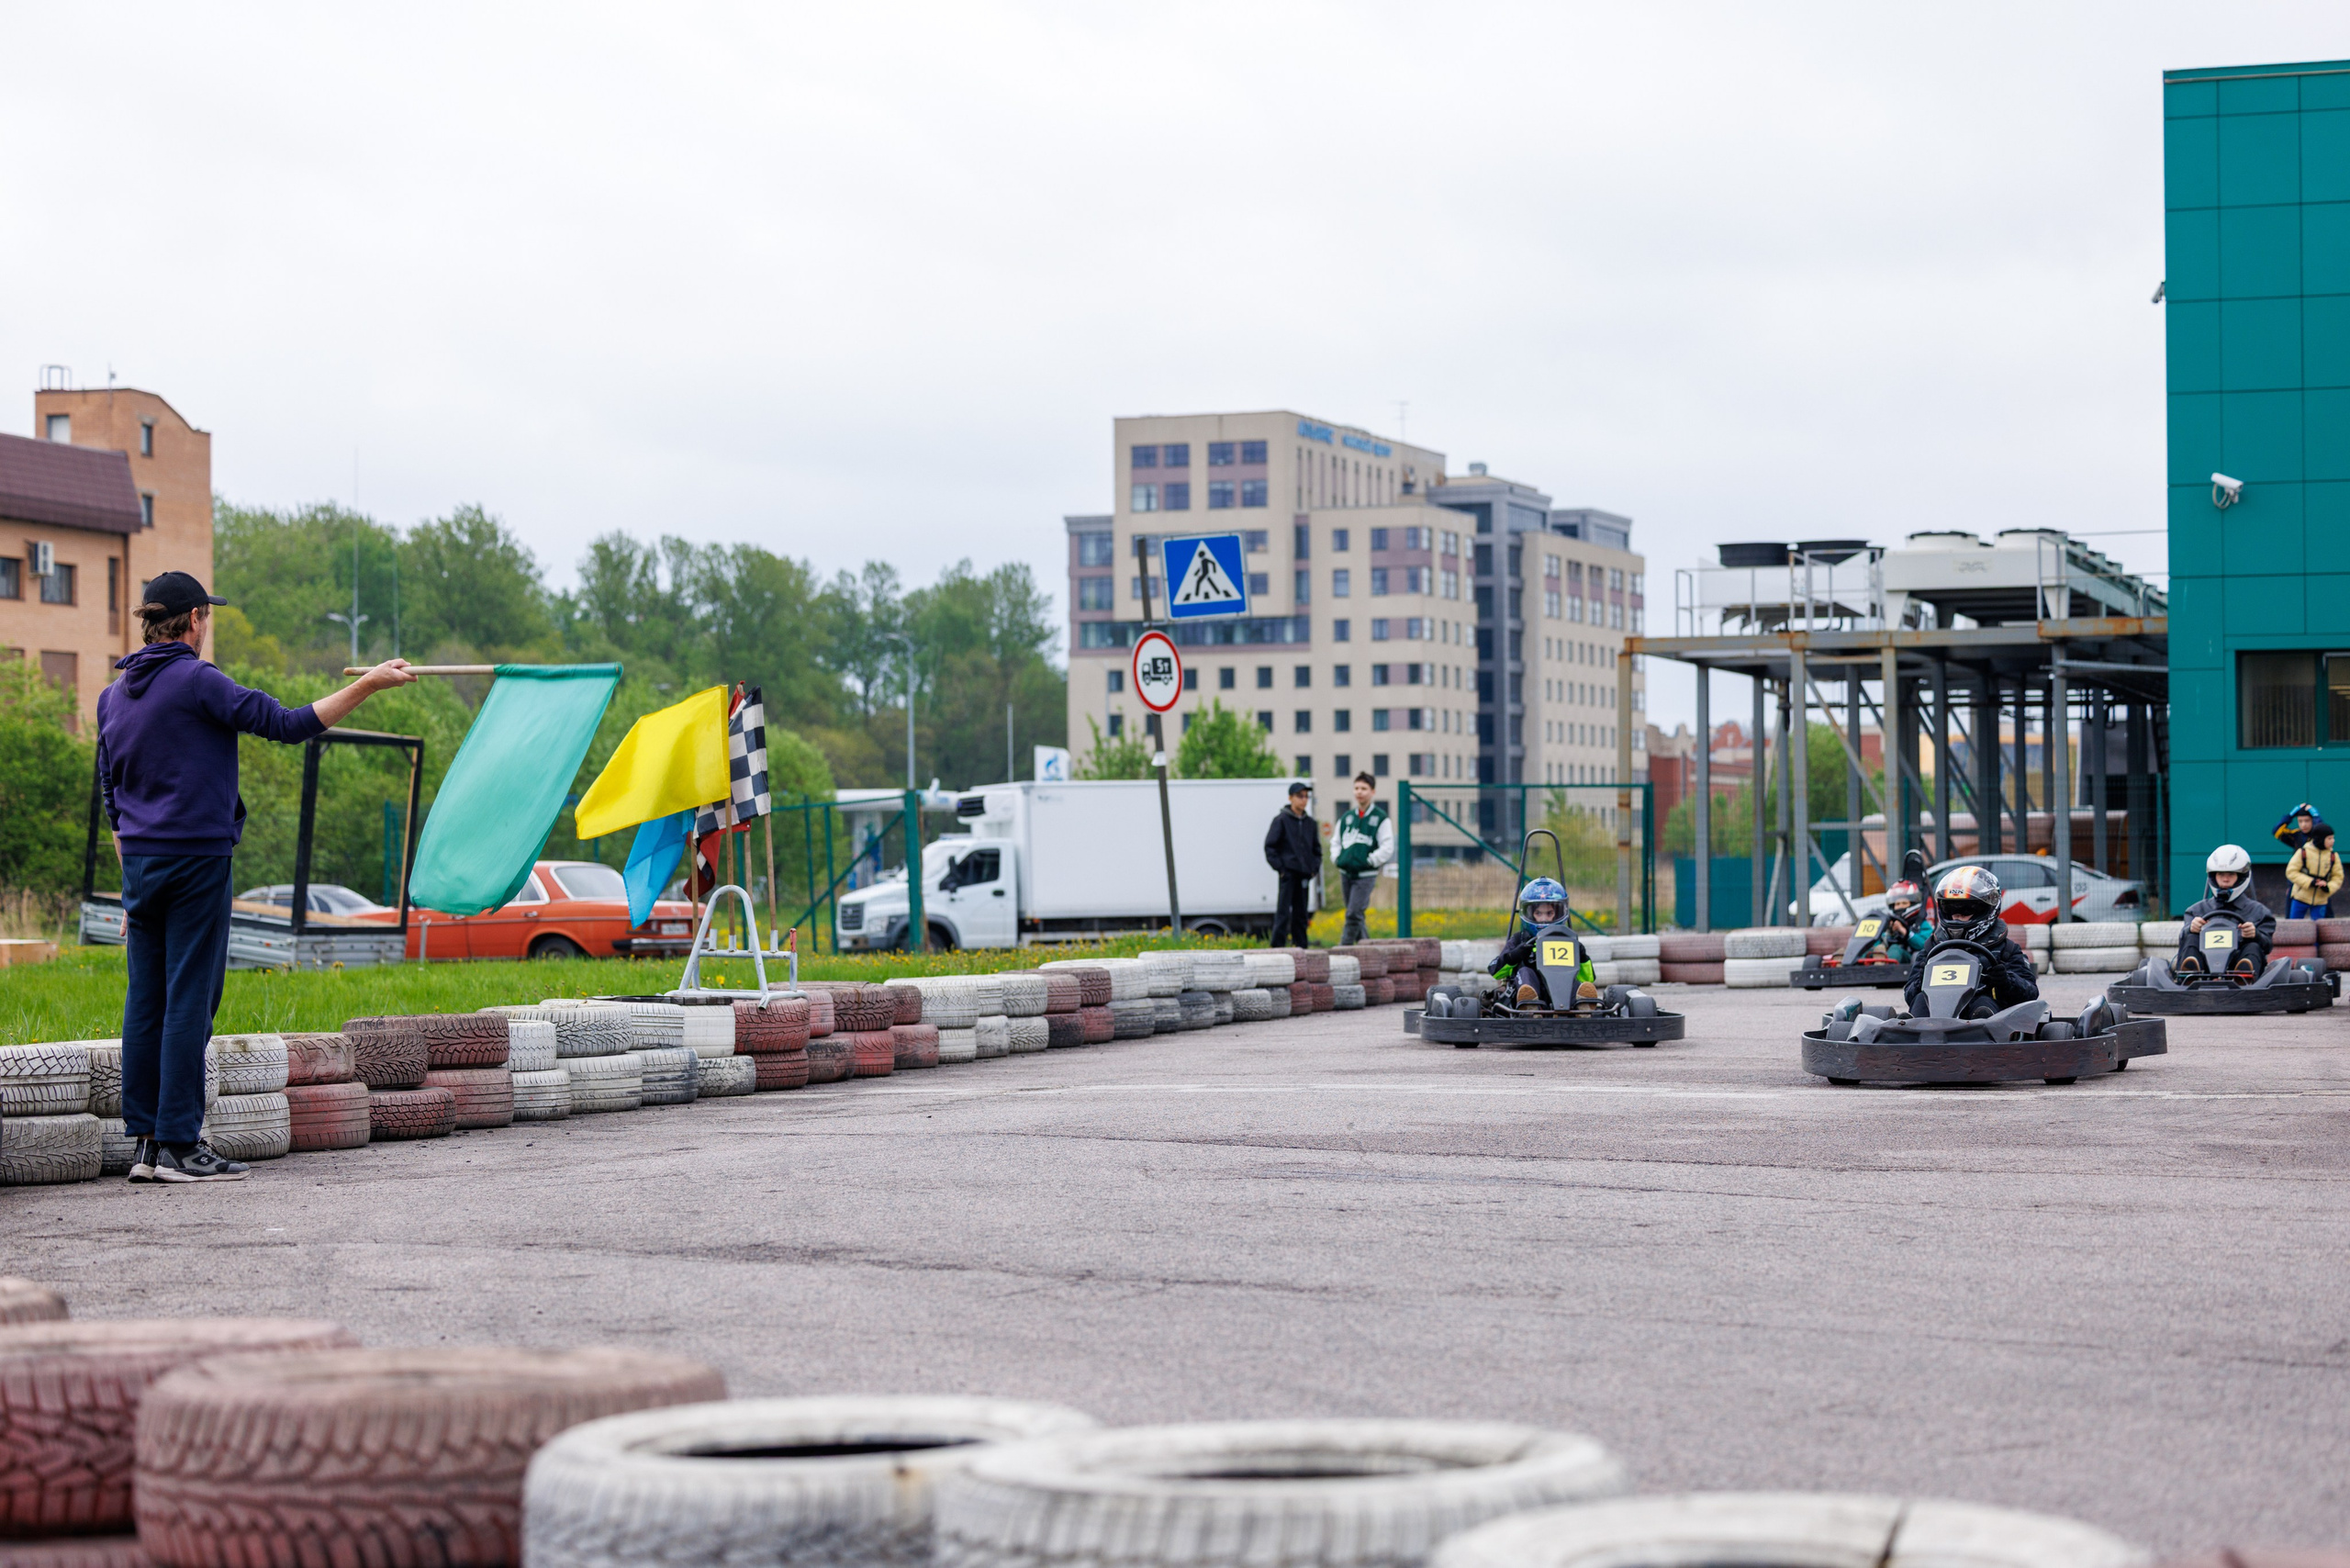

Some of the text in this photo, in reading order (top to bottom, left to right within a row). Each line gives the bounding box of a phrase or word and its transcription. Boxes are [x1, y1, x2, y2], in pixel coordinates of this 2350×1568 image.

[1863, 924, 1875, 933] 10
[2213, 935, 2225, 944] 2
[1550, 947, 1569, 960] 12
[1941, 969, 1958, 981] 3
